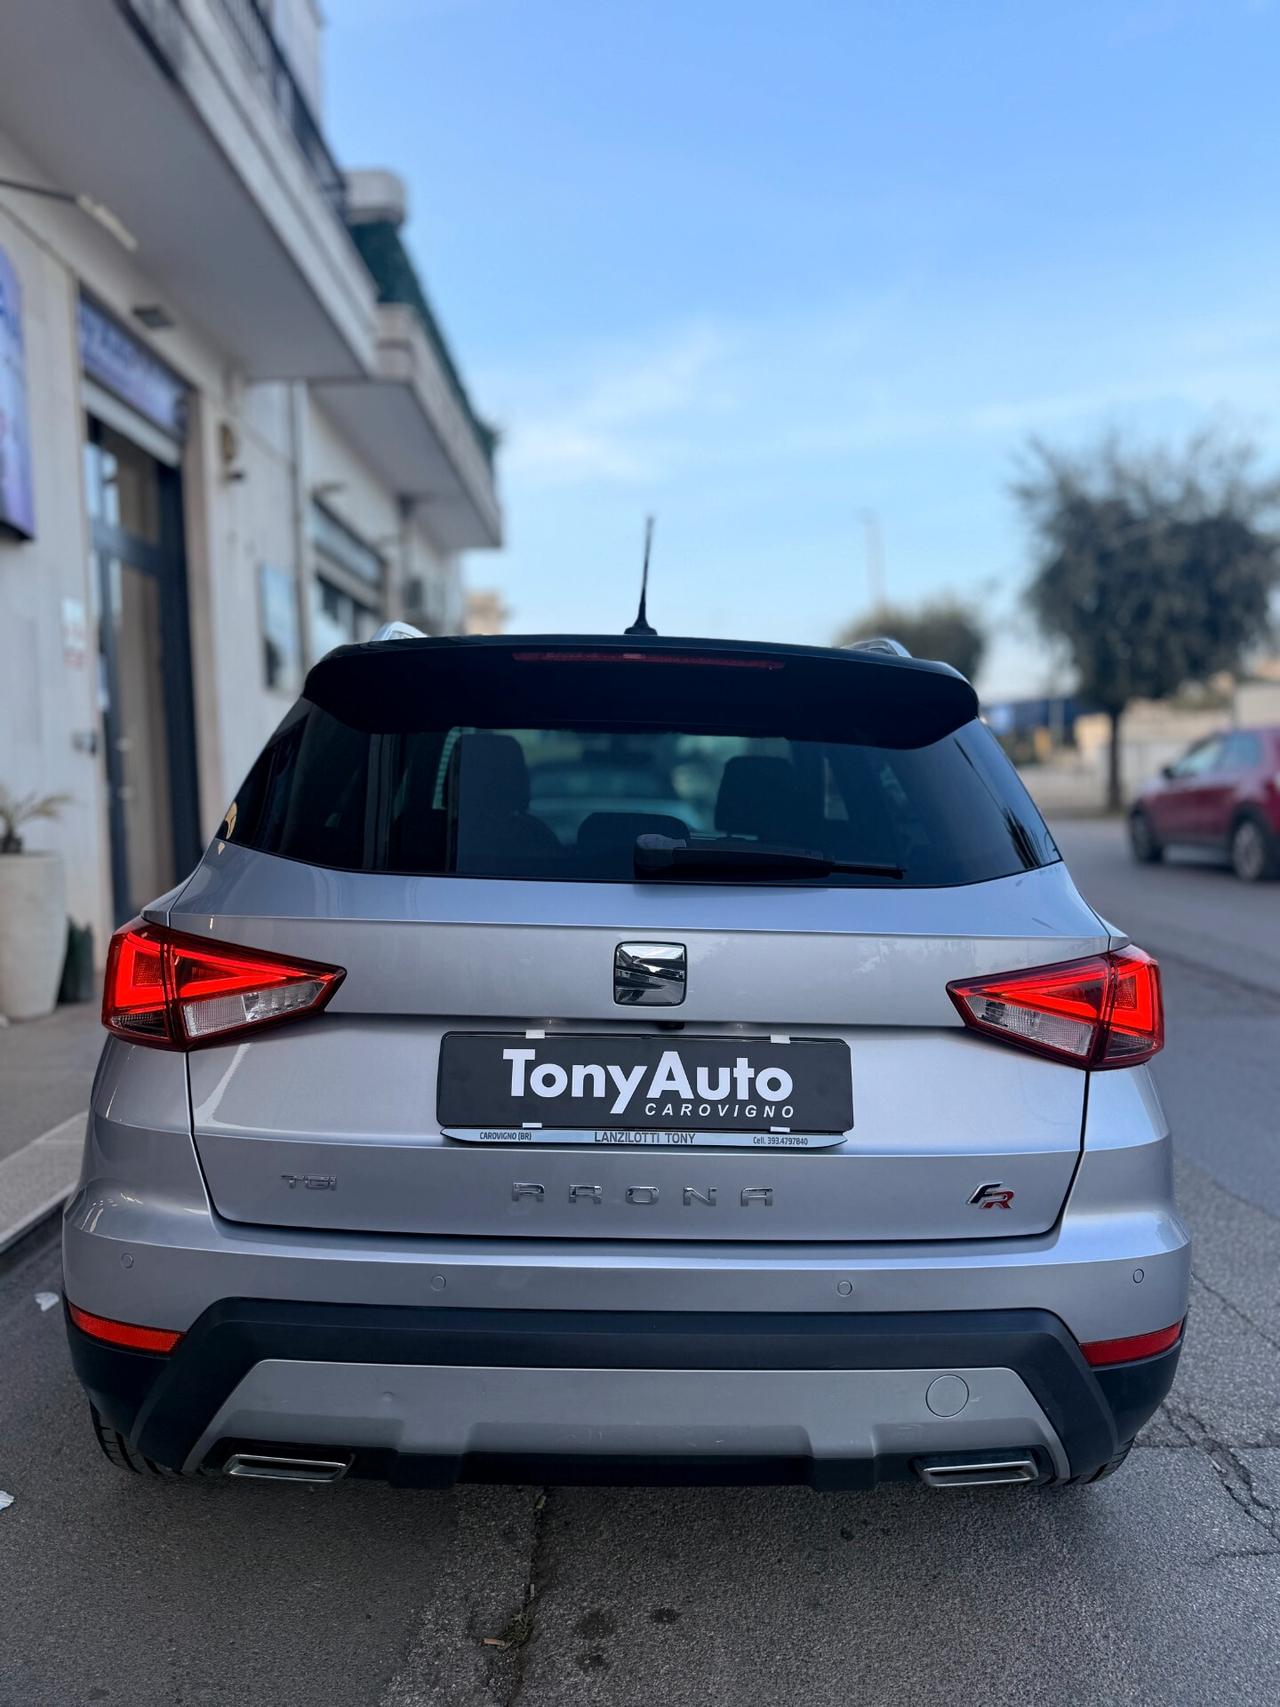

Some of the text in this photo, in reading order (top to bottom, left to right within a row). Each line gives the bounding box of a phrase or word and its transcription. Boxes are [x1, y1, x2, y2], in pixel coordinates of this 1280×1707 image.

[645, 1103, 794, 1119] CAROVIGNO
[479, 1131, 532, 1141] CAROVIGNO (BR)
[594, 1131, 696, 1144] LANZILOTTI TONY
[753, 1136, 766, 1145] Cell.
[281, 1174, 337, 1191] TGI
[511, 1182, 774, 1207] ARONA
[967, 1181, 1015, 1209] FR
